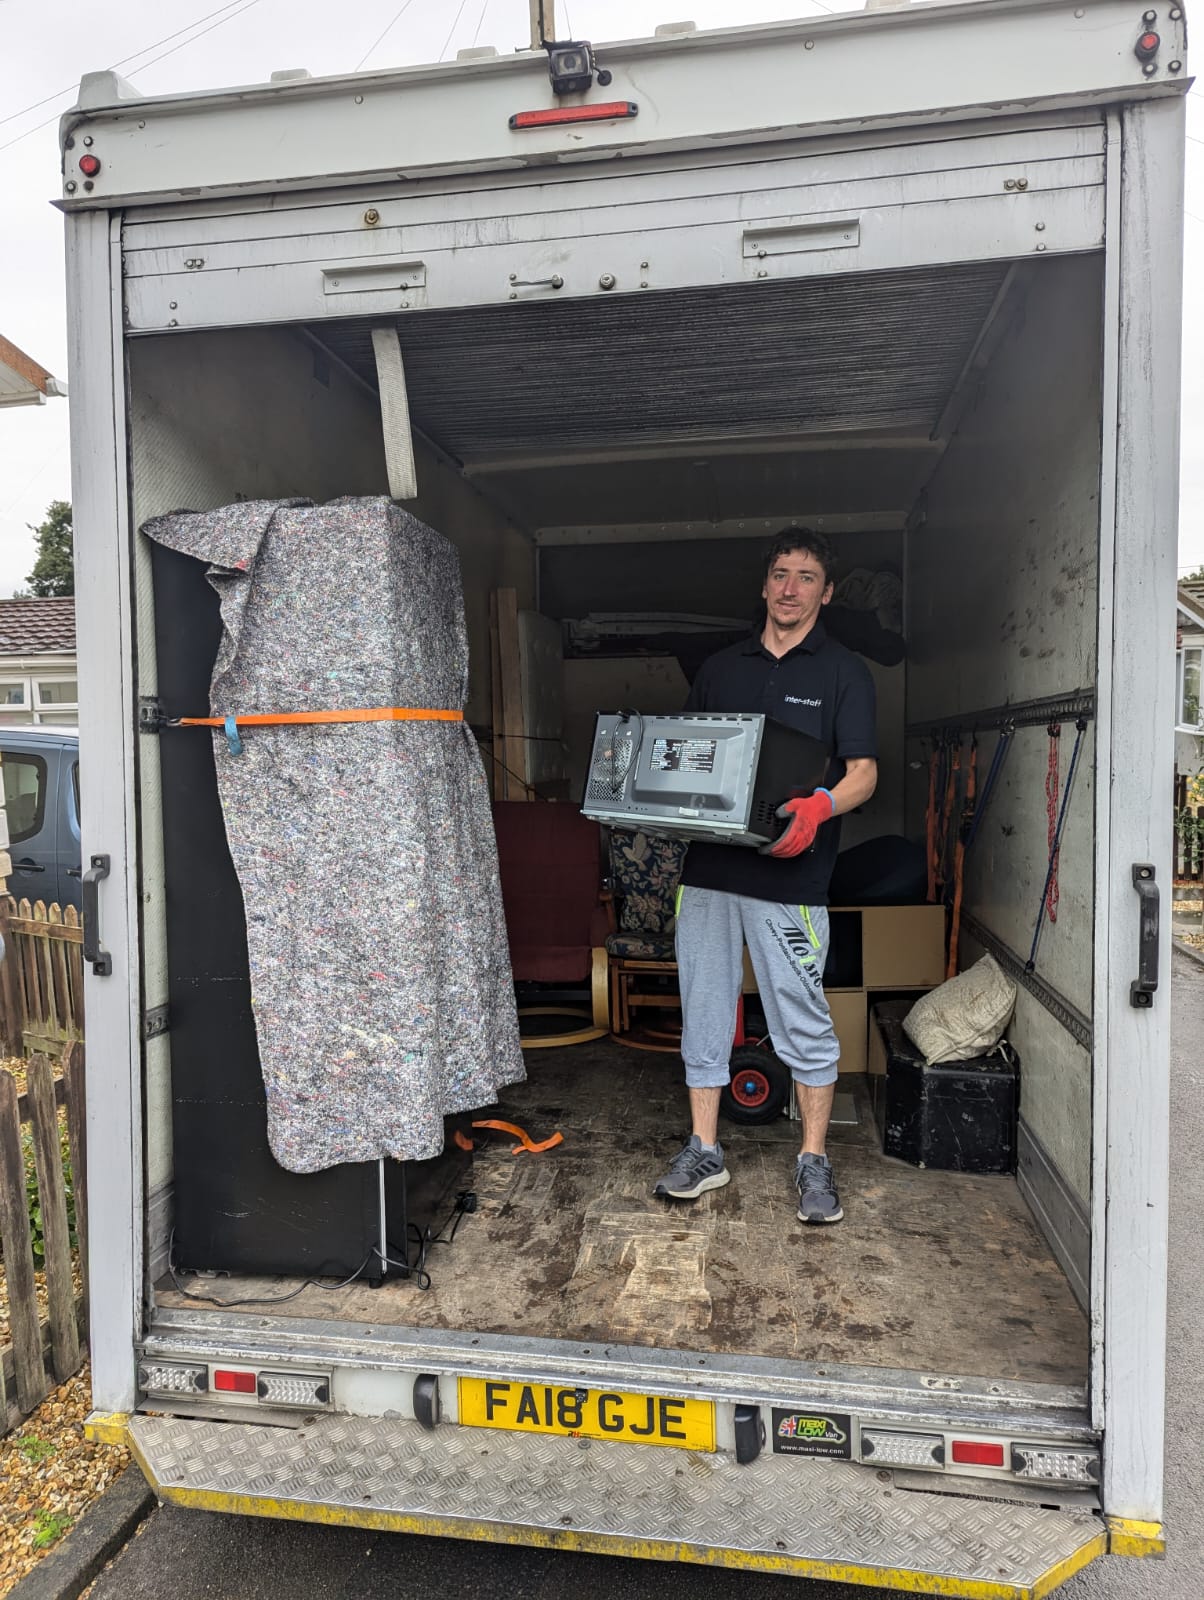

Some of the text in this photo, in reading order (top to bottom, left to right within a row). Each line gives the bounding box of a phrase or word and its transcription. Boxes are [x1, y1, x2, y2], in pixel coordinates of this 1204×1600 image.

[784, 694, 822, 707] inter-staff
[485, 1382, 687, 1440] FA18 GJE
[825, 1431, 839, 1439] Van
[780, 1445, 844, 1454] www.maxi-low.com
